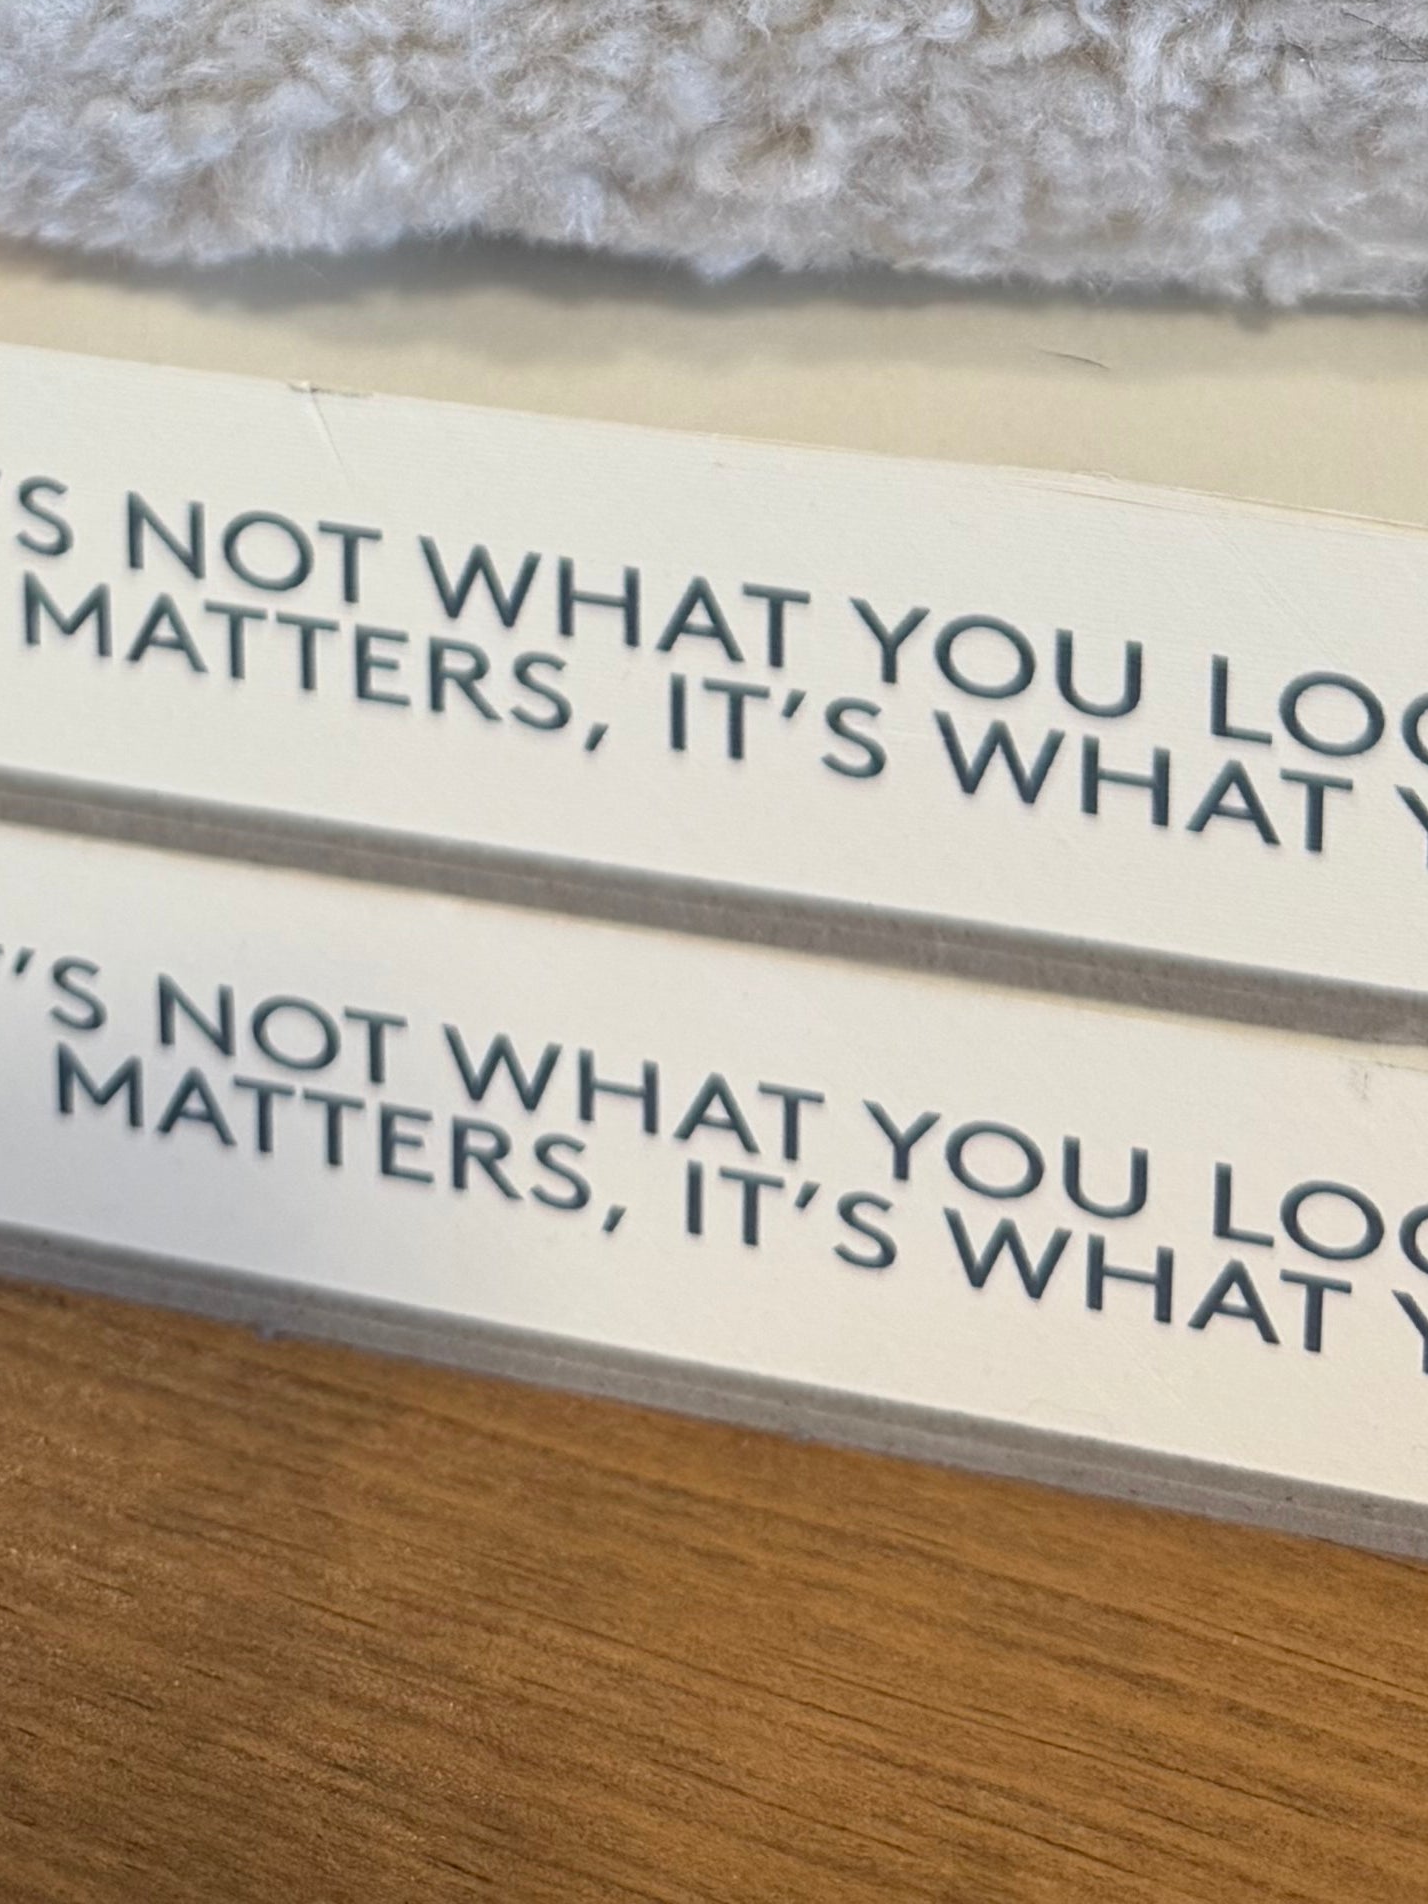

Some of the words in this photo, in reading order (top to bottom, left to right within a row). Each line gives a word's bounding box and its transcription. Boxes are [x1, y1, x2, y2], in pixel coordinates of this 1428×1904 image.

[24, 574, 607, 752] MATTERS,
[670, 676, 886, 779] IT'S
[935, 712, 1354, 854] WHAT
[127, 493, 382, 604] NOT
[420, 538, 810, 669] WHAT
[851, 599, 1143, 719] YOU
[56, 1044, 625, 1233] MATTERS,
[687, 1162, 896, 1270] IT'S
[944, 1209, 1353, 1354] WHAT
[158, 977, 406, 1086] NOT
[444, 1027, 824, 1162] WHAT
[865, 1103, 1148, 1220] YOU
